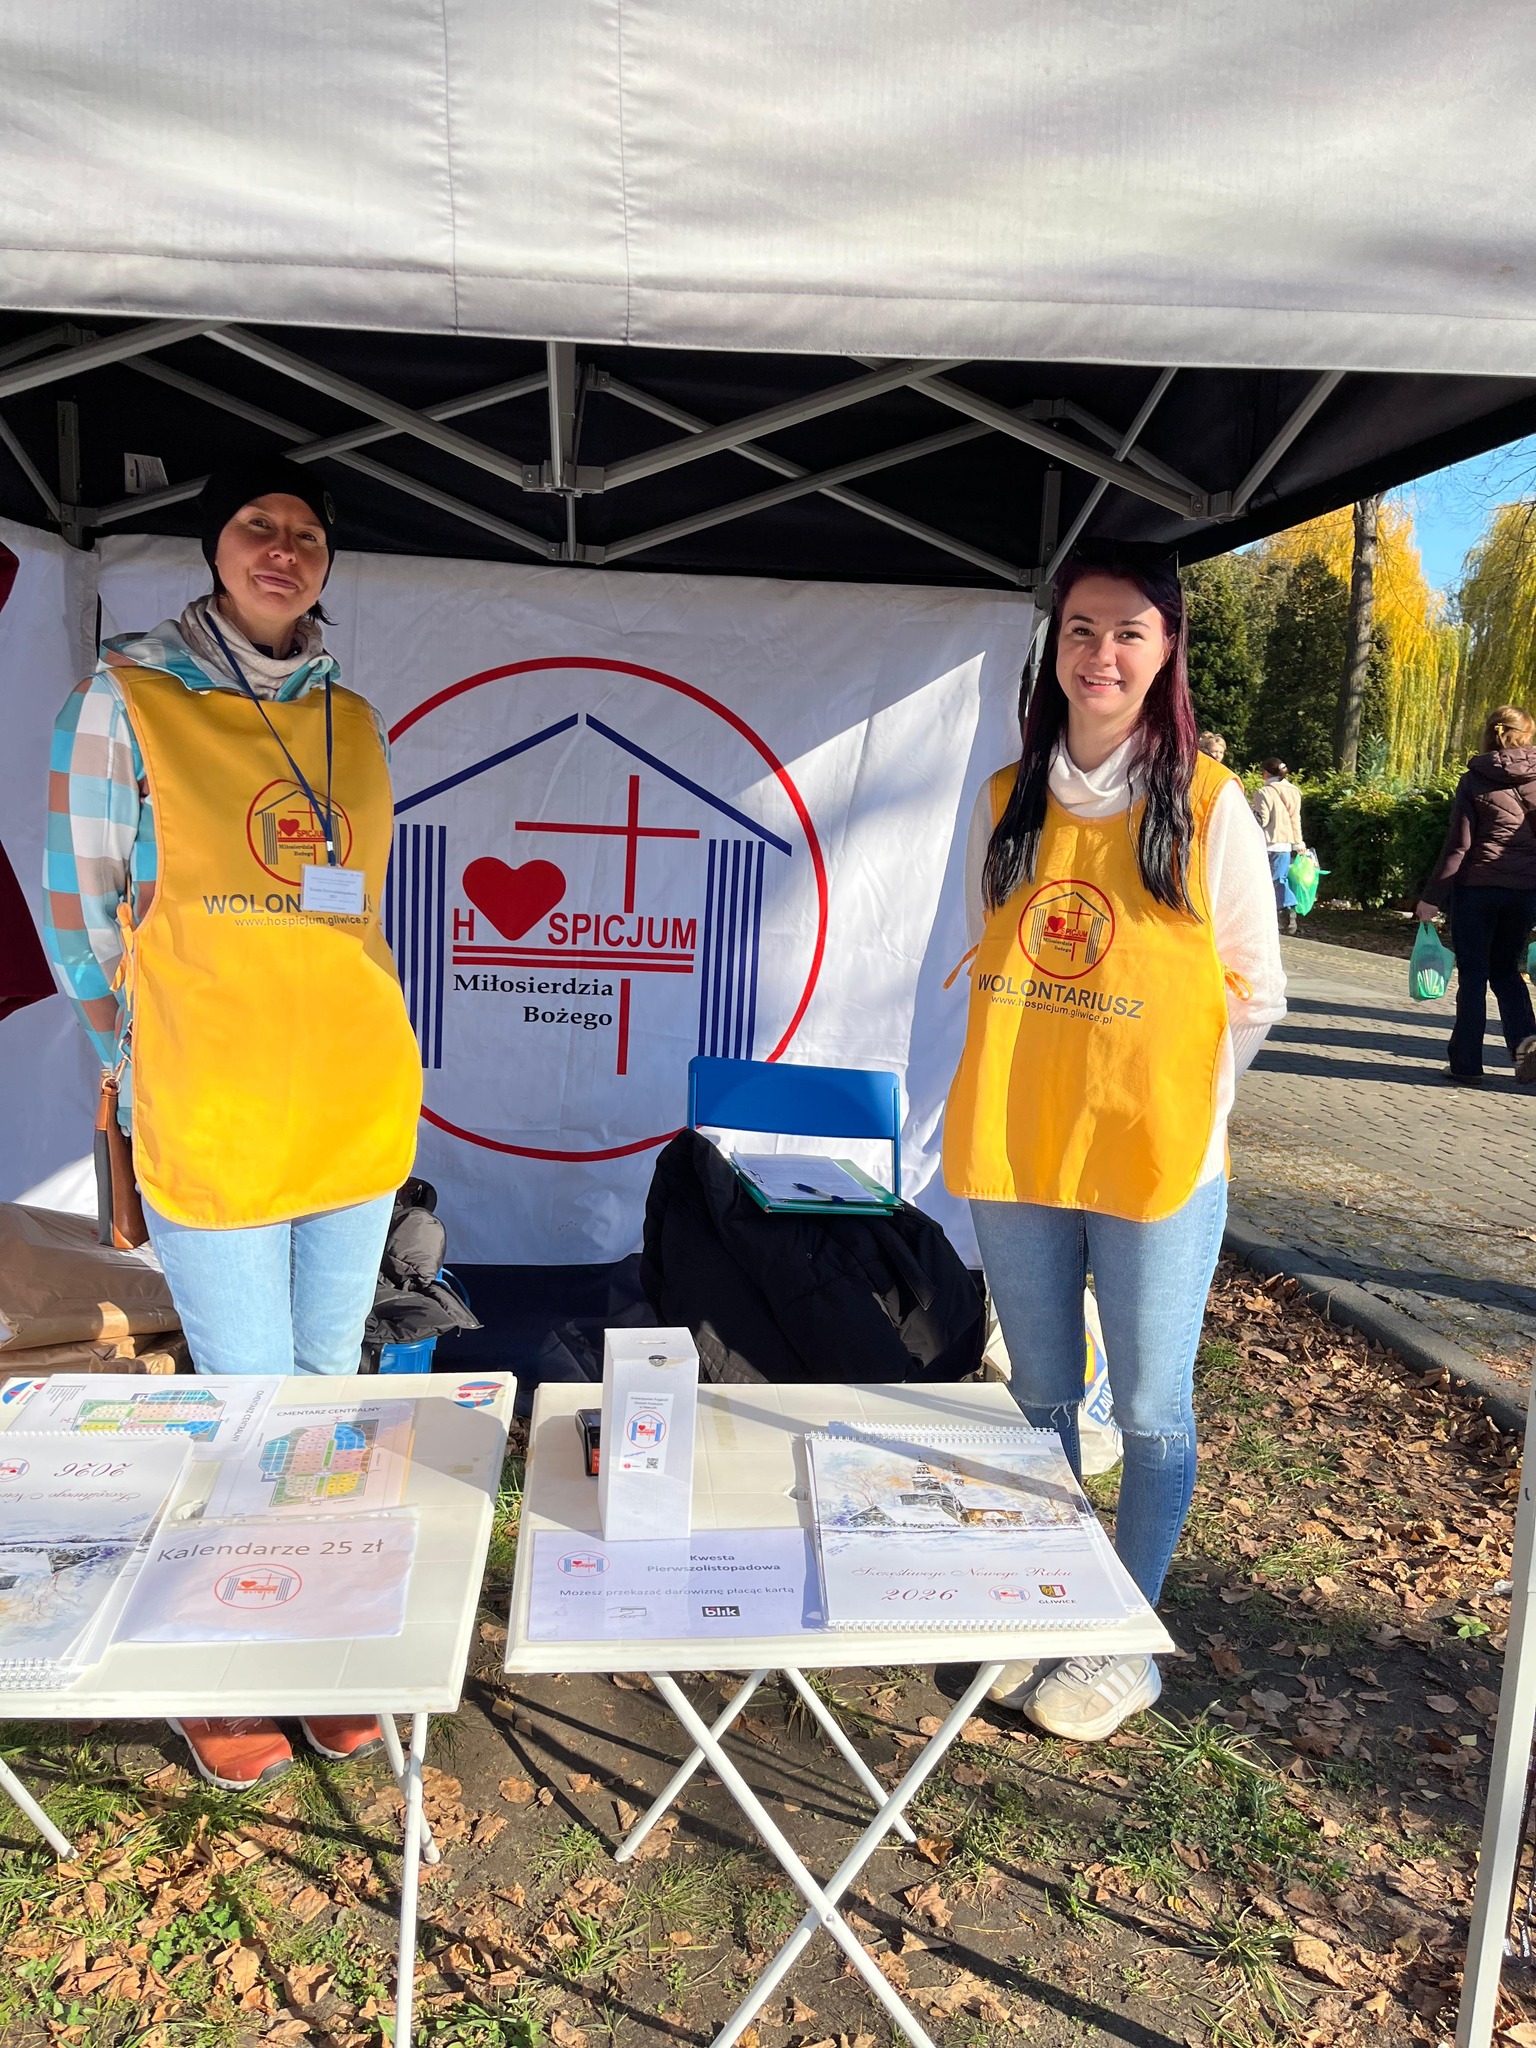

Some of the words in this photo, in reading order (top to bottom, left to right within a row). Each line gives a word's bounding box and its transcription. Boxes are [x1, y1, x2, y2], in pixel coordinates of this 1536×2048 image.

[453, 974, 614, 996] Miłosierdzia
[978, 973, 1144, 1019] WOLONTARIUSZ
[523, 1005, 613, 1030] Bożego
[991, 996, 1112, 1025] www.hospicjum.gliwice.pl
[277, 1409, 326, 1417] CMENTARZ
[54, 1463, 133, 1478] 2026
[157, 1543, 310, 1562] Kalendarze
[319, 1541, 353, 1555] 25
[362, 1539, 384, 1553] zł
[647, 1564, 781, 1572] Pierwszolistopadowa
[852, 1567, 946, 1580] Szczęśliwego
[951, 1567, 1018, 1579] Nowego
[1024, 1567, 1073, 1577] Roku
[606, 1588, 661, 1597] przekazać
[727, 1588, 762, 1596] płacąc
[881, 1589, 958, 1601] 2026
[705, 1606, 737, 1617] blik
